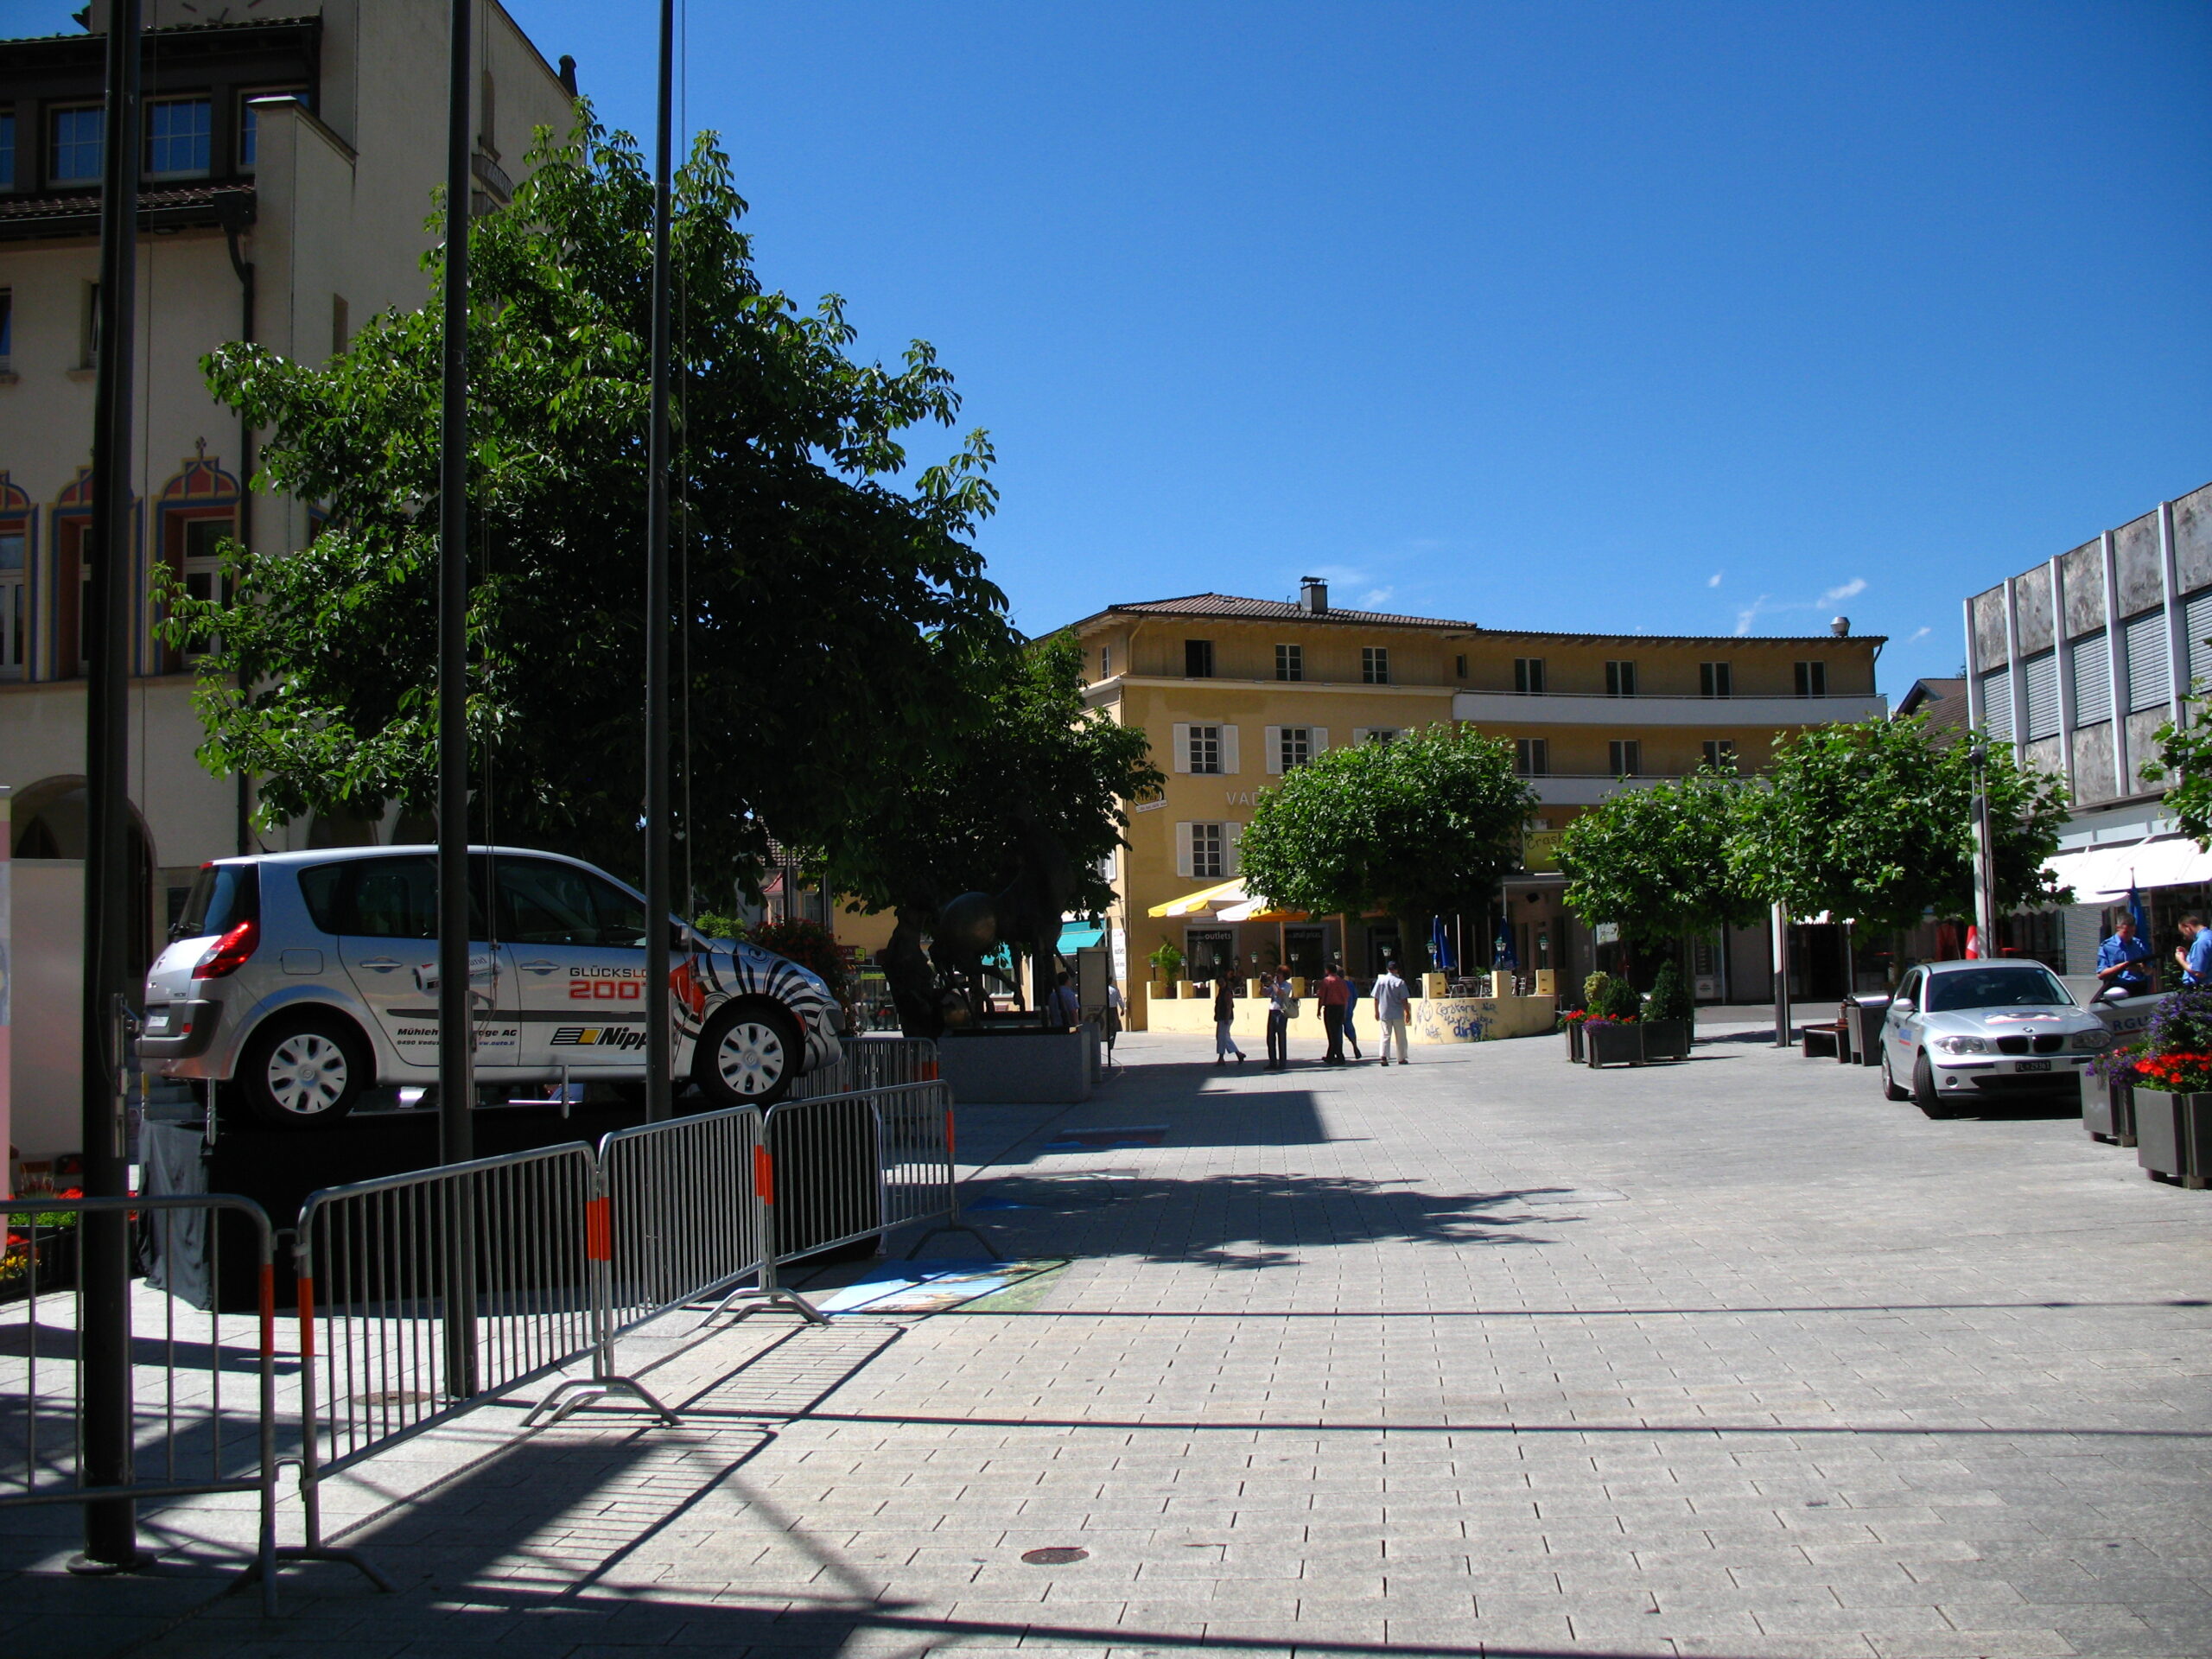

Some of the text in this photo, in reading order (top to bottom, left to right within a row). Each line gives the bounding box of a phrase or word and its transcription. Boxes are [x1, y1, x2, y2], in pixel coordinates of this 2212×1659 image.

[1226, 791, 1262, 806] VAD
[1205, 931, 1231, 940] outlets
[570, 964, 647, 978] GLÜCKSL
[569, 980, 647, 1000] 200
[2113, 1015, 2149, 1031] RGU
[397, 1027, 439, 1036] Mühleh
[597, 1027, 647, 1050] Nipp
